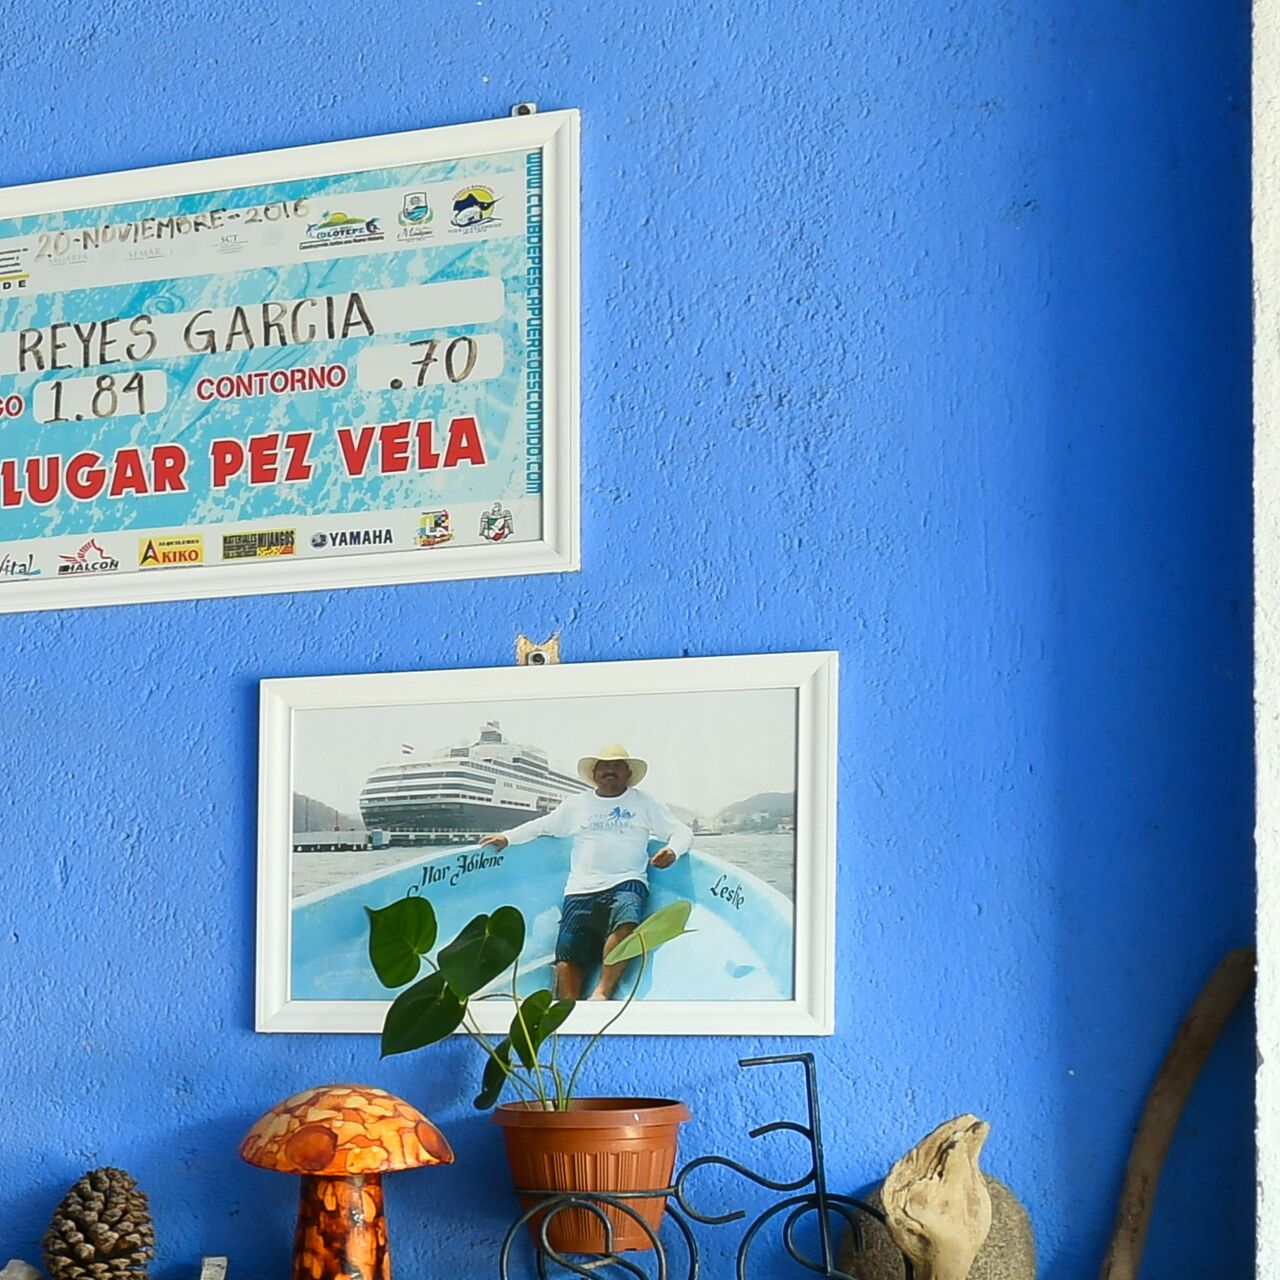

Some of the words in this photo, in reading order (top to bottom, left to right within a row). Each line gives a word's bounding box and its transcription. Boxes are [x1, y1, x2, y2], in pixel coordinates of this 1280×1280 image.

[19, 315, 158, 372] REYES
[183, 292, 375, 355] GARCIA
[196, 365, 347, 401] CONTORNO
[390, 336, 478, 389] .70
[44, 373, 146, 424] 1.84
[0, 443, 186, 508] LUGAR
[211, 432, 313, 488] PEZ
[337, 416, 486, 477] VELA
[162, 549, 199, 564] KIKO
[329, 529, 393, 547] YAMAHA
